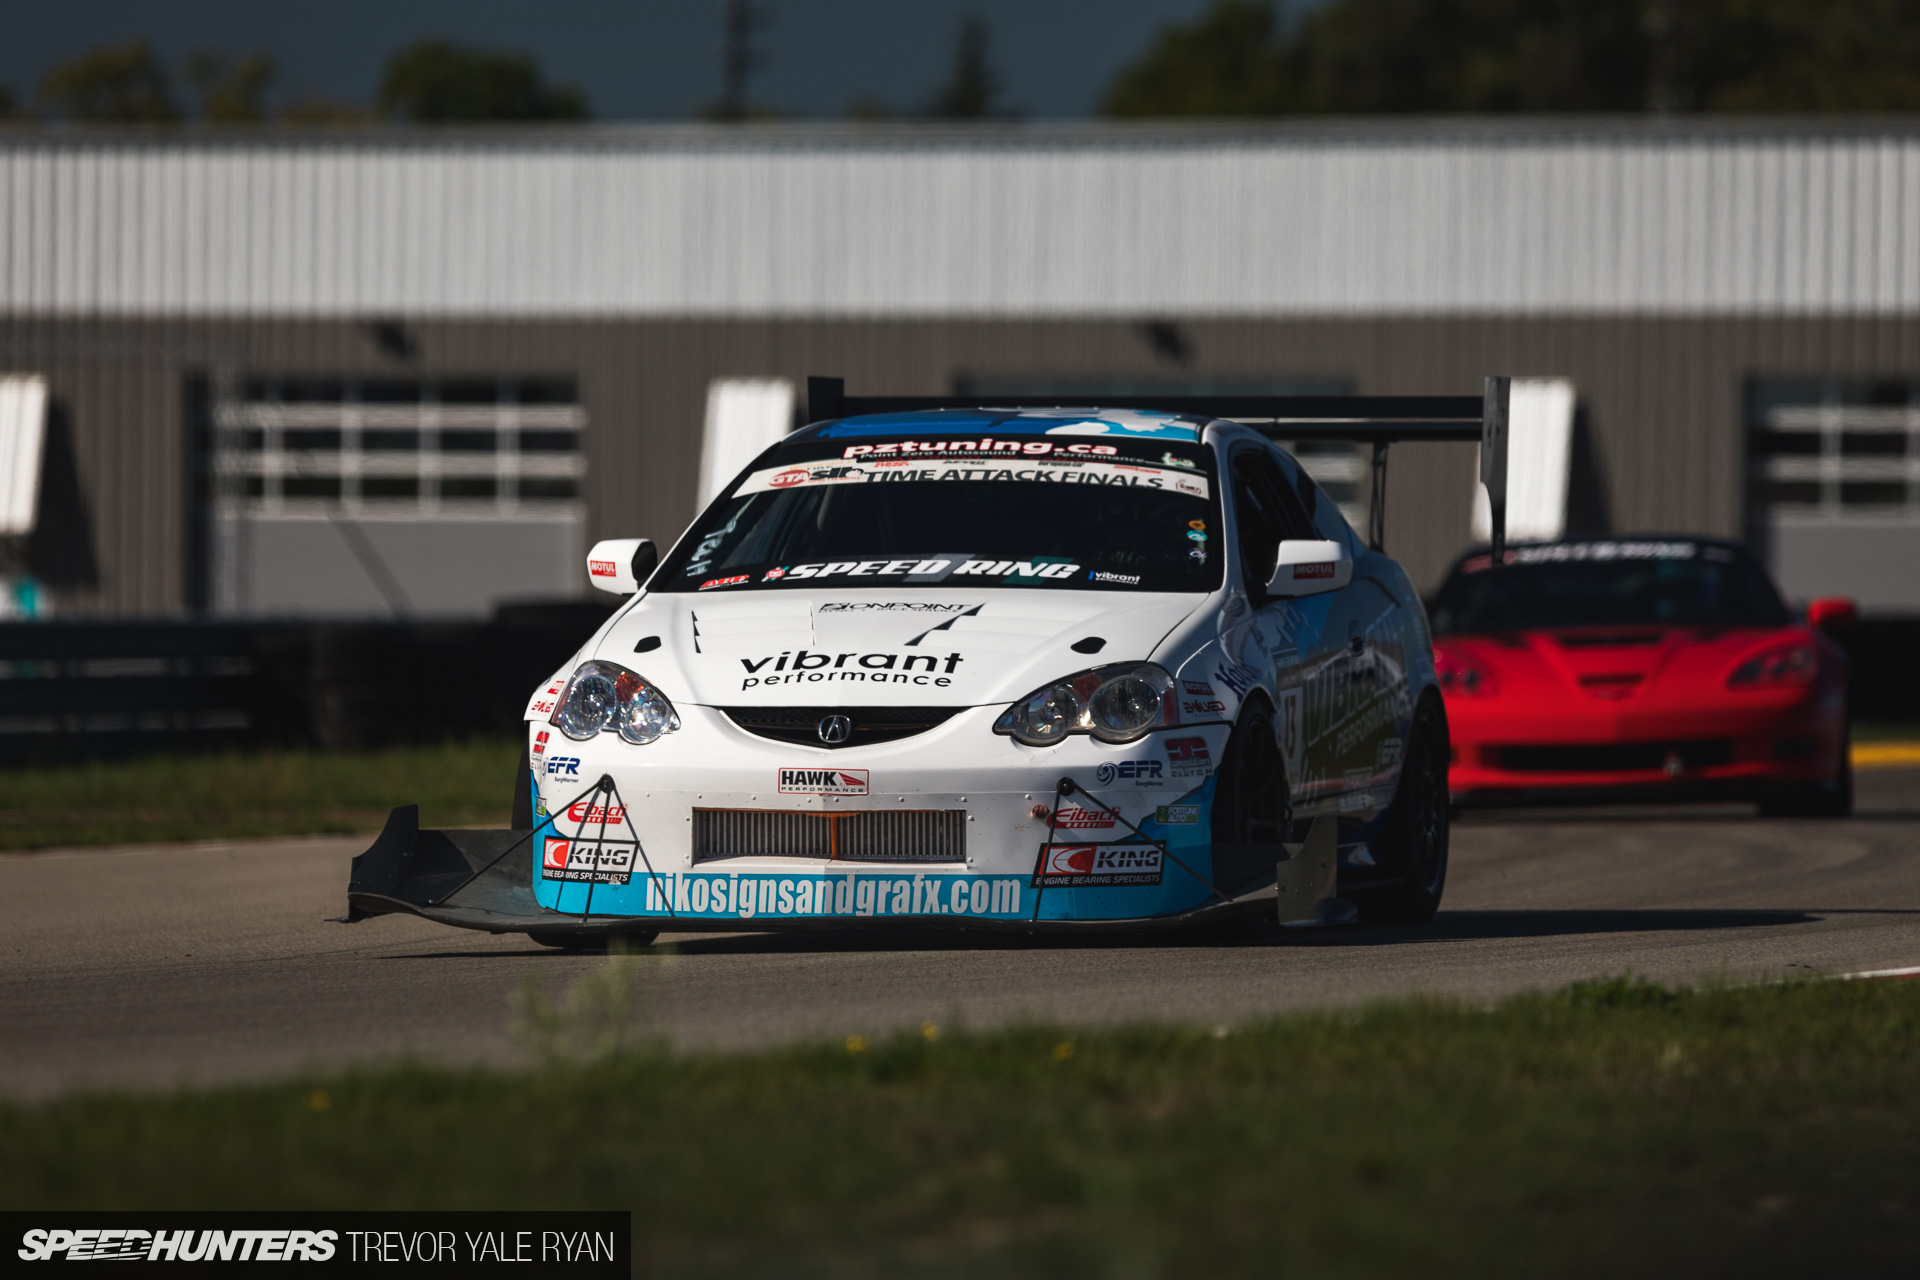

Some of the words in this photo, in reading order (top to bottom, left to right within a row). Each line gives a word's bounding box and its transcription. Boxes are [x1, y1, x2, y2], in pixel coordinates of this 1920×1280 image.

[843, 438, 1117, 459] pztuning.ca
[1053, 451, 1145, 463] Performance
[771, 471, 806, 485] GTA
[864, 470, 936, 483] TIME
[937, 469, 1057, 482] ATTACK
[1058, 470, 1164, 489] FINALS
[591, 561, 615, 573] MOTUL
[782, 559, 951, 580] SPEED
[952, 559, 1081, 578] RING
[1295, 563, 1334, 575] MOTUL
[1095, 571, 1141, 583] vibrant
[741, 650, 964, 675] vibrant
[741, 671, 953, 691] performance
[1183, 680, 1211, 692] MOTUL
[547, 756, 581, 775] EFR
[1118, 760, 1163, 778] EFR
[1171, 757, 1212, 768] competition
[781, 770, 837, 786] HAWK
[1172, 769, 1213, 778] CLUTCH
[567, 801, 627, 824] Eibach
[1047, 806, 1121, 828] Eibach
[1168, 806, 1199, 815] FORTUNE
[1168, 814, 1186, 822] AUTO
[569, 847, 630, 866] KING
[1097, 850, 1160, 868] KING
[554, 869, 579, 880] BEARING
[580, 871, 629, 882] SPECIALISTS
[1036, 877, 1070, 885] ENGINE
[1072, 876, 1111, 884] BEARING
[1113, 874, 1160, 883] SPECIALISTS
[645, 873, 1021, 918] nikosignsandgrafx.com
